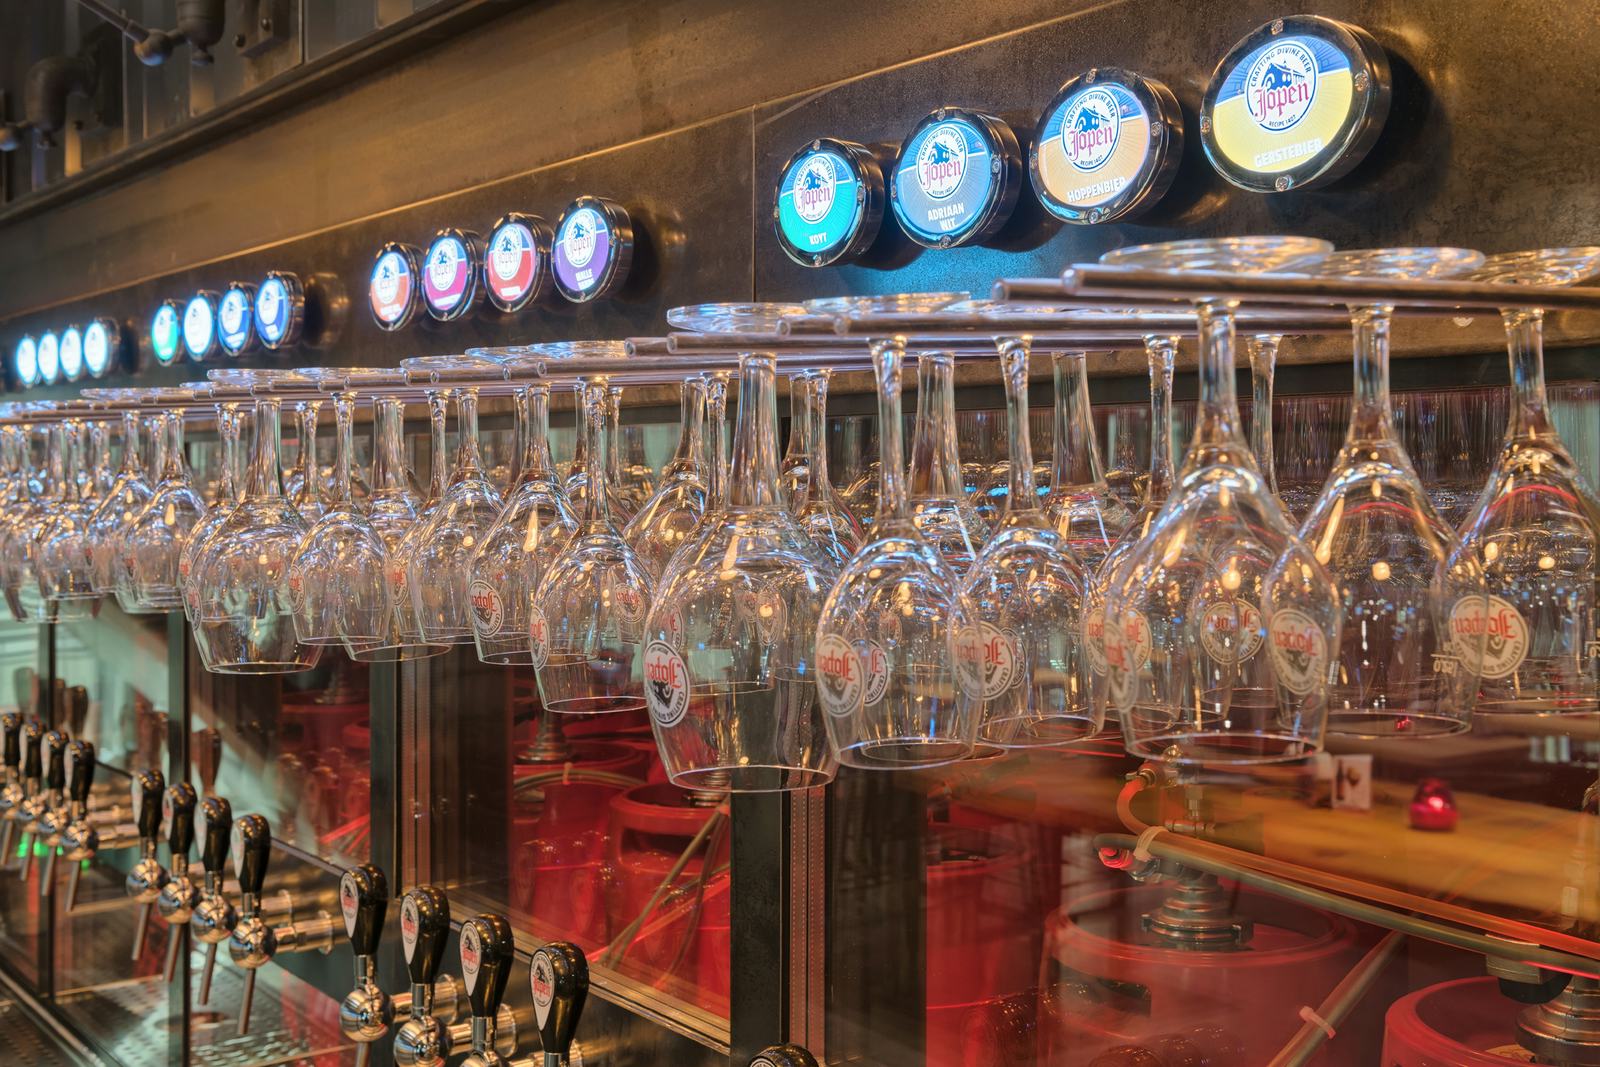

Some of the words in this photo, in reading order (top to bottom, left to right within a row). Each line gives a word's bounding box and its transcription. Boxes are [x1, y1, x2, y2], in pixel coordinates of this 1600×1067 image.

[1250, 51, 1275, 87] CRAFTING
[1277, 47, 1300, 57] DIVINE
[1300, 54, 1312, 73] BEER
[1066, 98, 1088, 128] CRAFTING
[1088, 94, 1107, 103] DIVINE
[1106, 100, 1116, 118] BEER
[1254, 82, 1309, 122] Jopen
[1068, 126, 1113, 162] Jopen
[922, 160, 961, 190] Jopen
[798, 187, 830, 213] Jopen
[927, 203, 965, 222] ADRIAAN
[808, 232, 827, 245] KOYT
[939, 217, 956, 231] WIT
